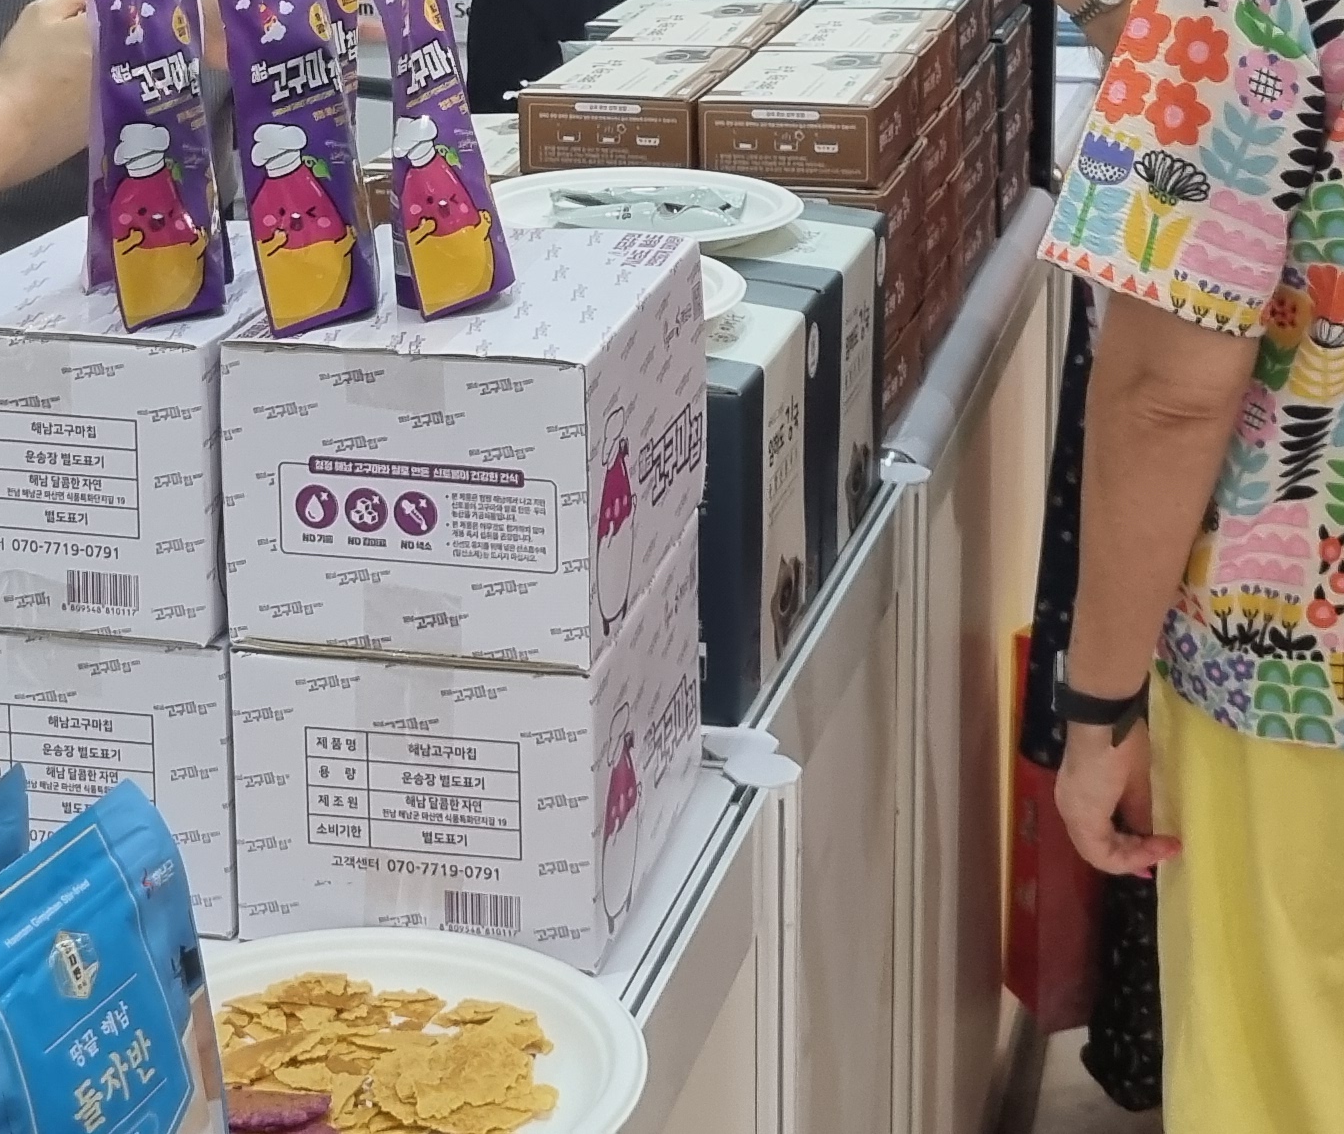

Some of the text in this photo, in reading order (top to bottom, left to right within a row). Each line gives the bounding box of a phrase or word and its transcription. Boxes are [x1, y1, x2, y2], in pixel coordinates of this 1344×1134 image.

[31, 421, 96, 438] 해남고구마칩
[61, 453, 104, 468] 별도표기
[45, 511, 88, 525] 별도표기
[12, 539, 119, 560] 070-7719-0791
[48, 715, 113, 732] 해남고구마칩
[78, 746, 121, 761] 별도표기
[408, 743, 476, 760] 해남고구마칩
[439, 774, 485, 790] 별도표기
[316, 823, 468, 847] 소비기한 별도표기
[331, 855, 500, 881] 고객센터 070-7719-0791
[70, 1001, 129, 1067] 땅끝 해남
[74, 1028, 156, 1133] 돌자반
